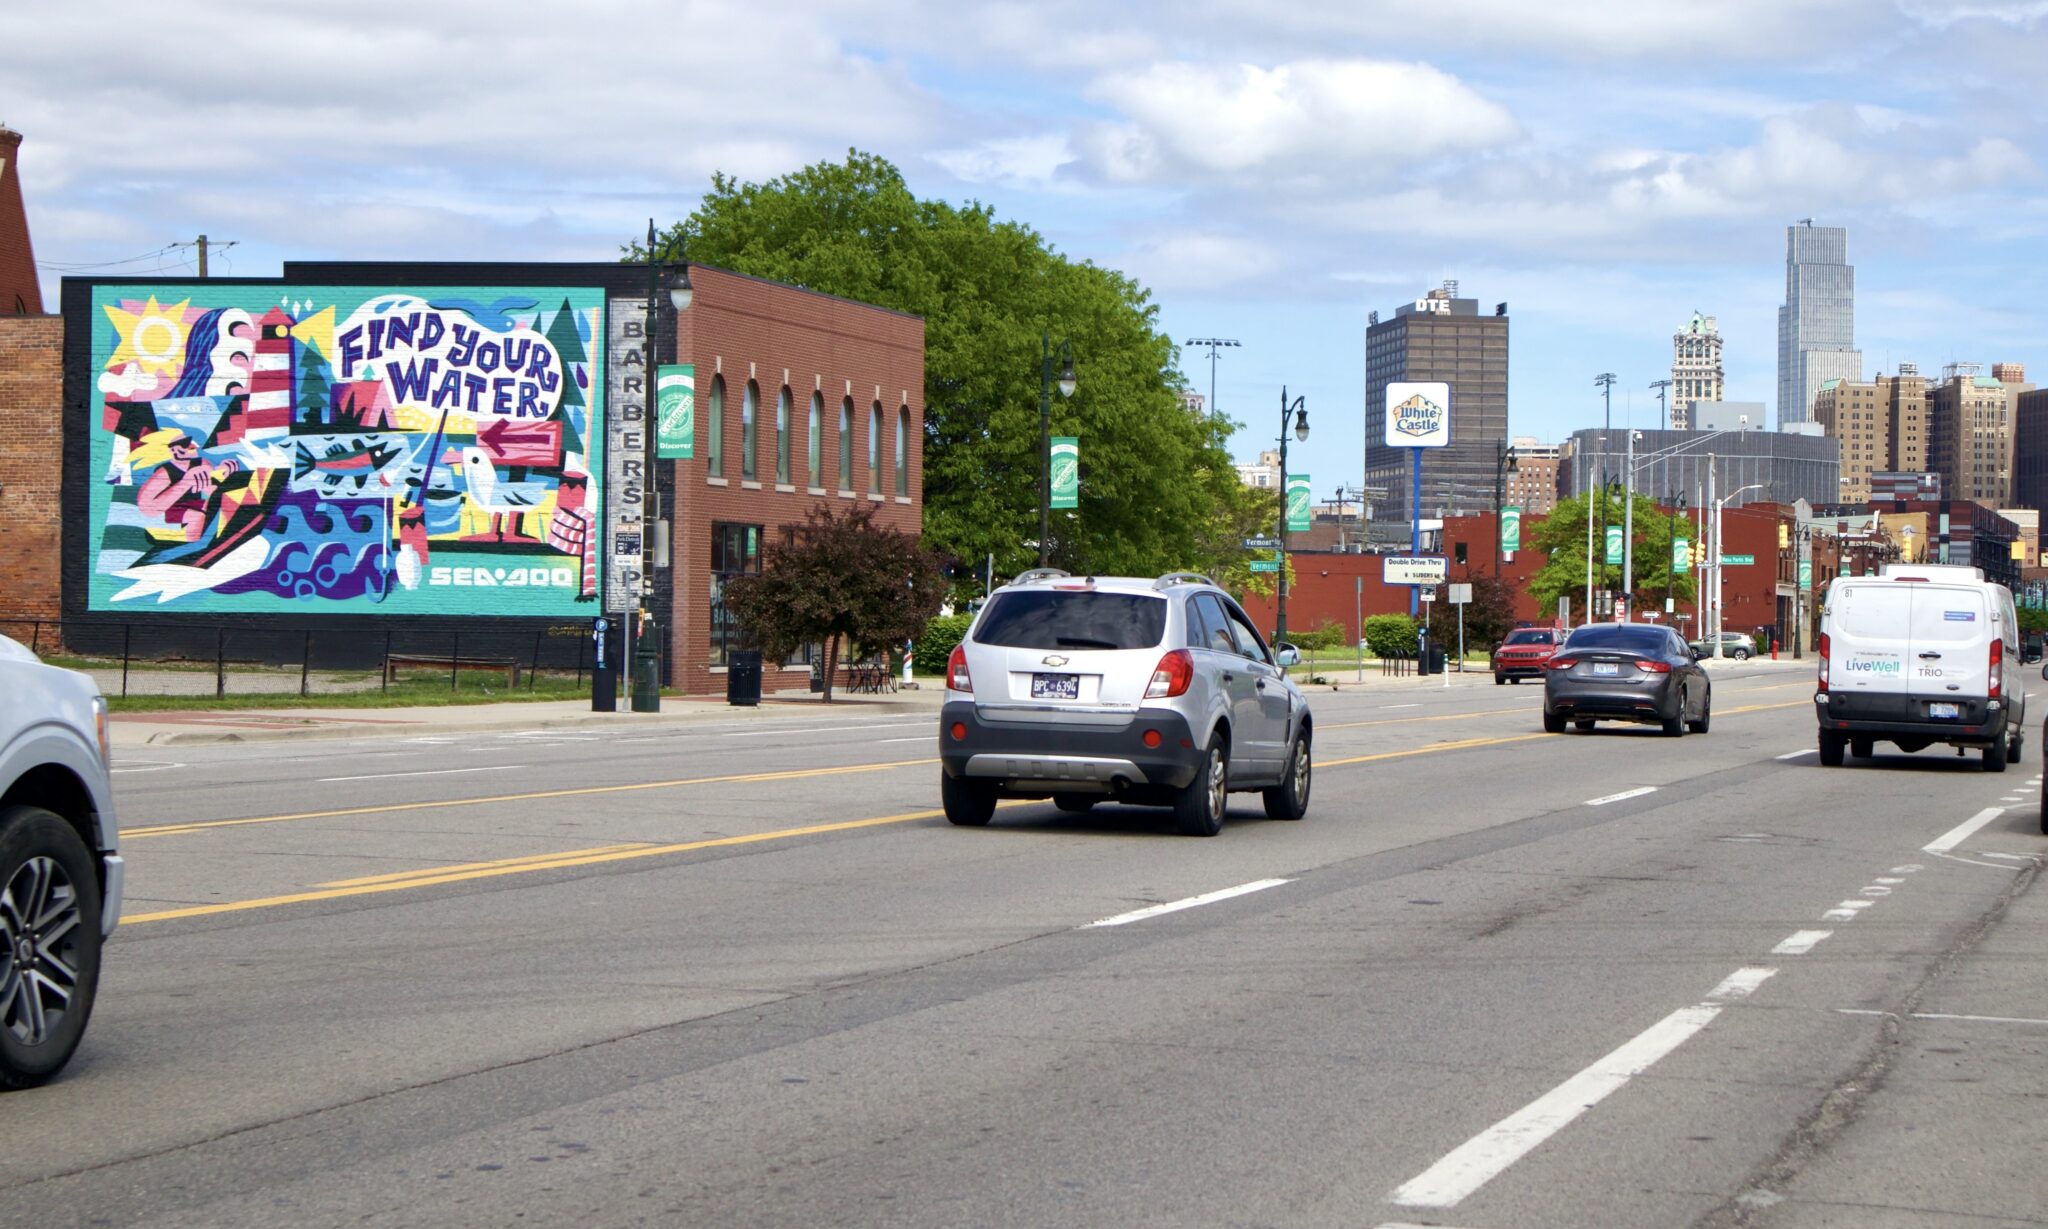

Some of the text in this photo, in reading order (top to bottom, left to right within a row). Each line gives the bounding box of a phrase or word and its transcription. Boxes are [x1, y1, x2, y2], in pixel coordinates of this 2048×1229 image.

[1415, 299, 1450, 312] DTE
[339, 312, 560, 393] FIND YOUR
[386, 356, 550, 418] WATER
[660, 395, 693, 435] Corktown
[1400, 407, 1437, 419] White
[1397, 418, 1438, 430] Castle
[1246, 538, 1272, 546] Vermont
[1388, 558, 1409, 566] Double
[1844, 588, 1853, 598] 81
[1846, 658, 1900, 672] LiveWell
[1918, 668, 1943, 677] TRIO
[1034, 680, 1076, 692] BPC 6394
